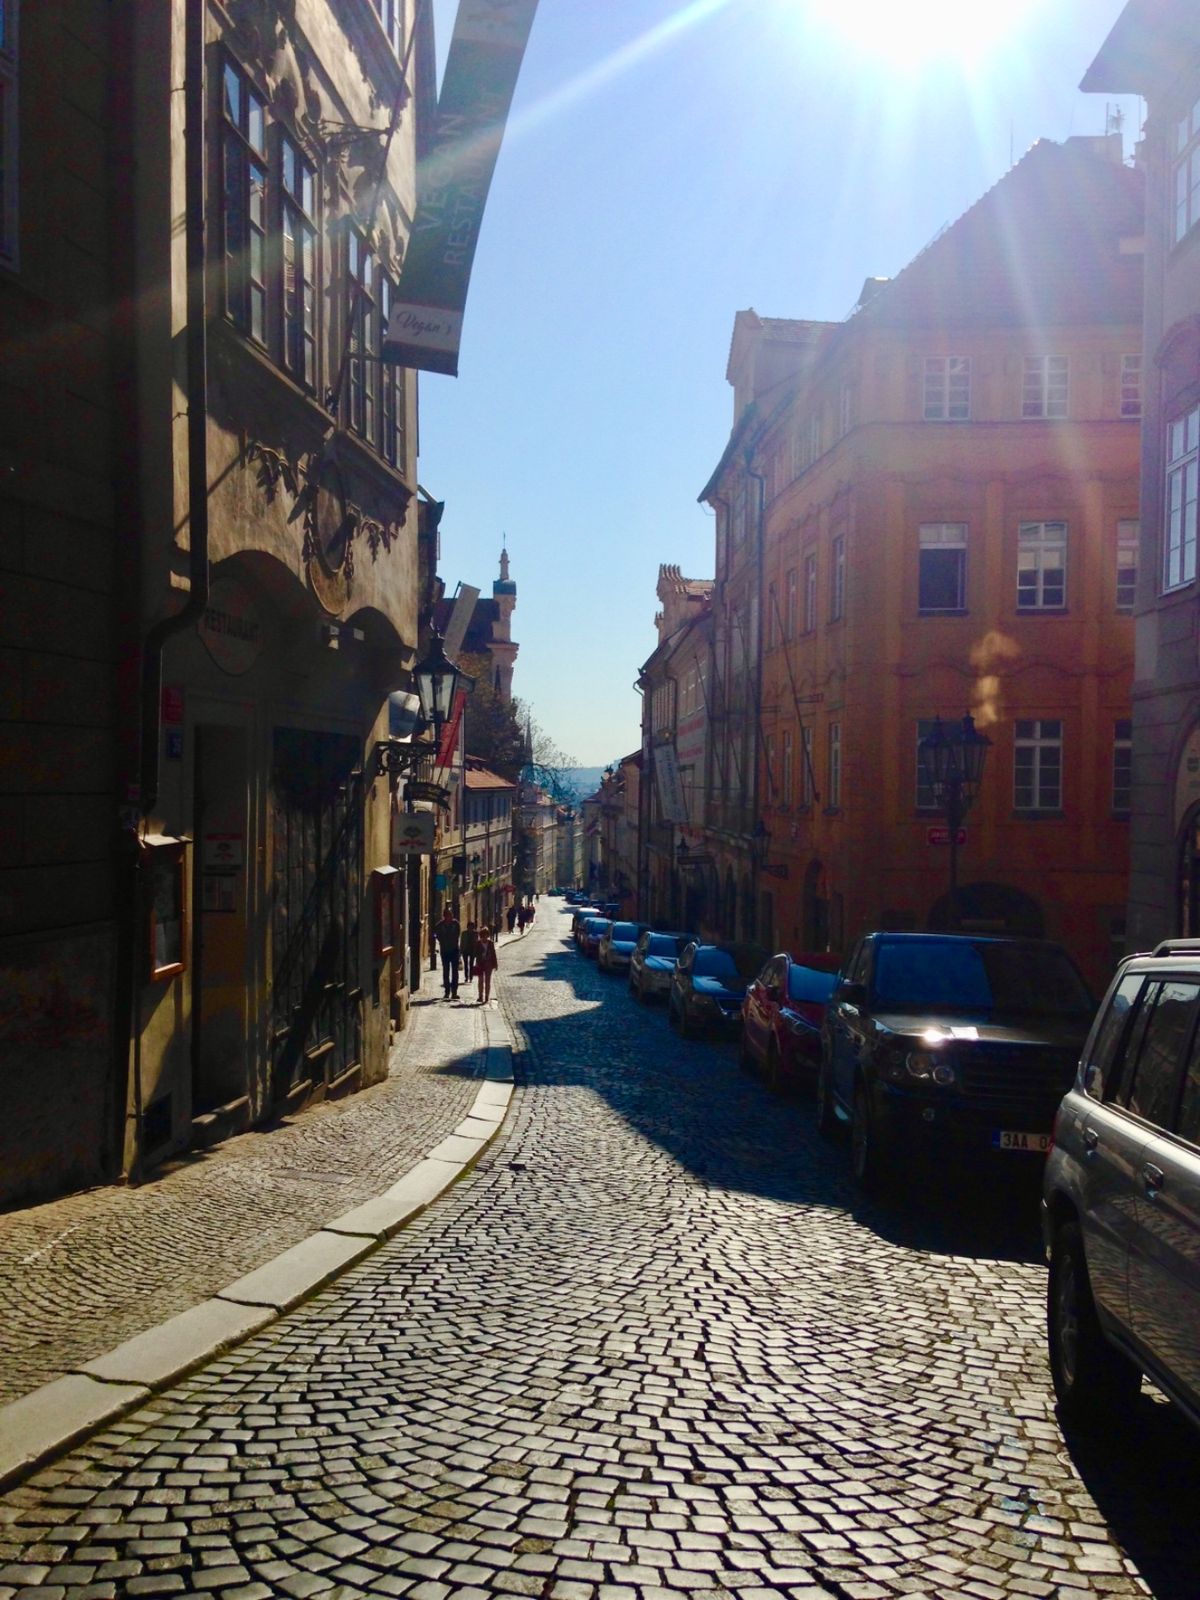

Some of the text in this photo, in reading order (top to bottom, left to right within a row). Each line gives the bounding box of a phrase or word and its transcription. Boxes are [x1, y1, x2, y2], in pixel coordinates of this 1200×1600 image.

[416, 113, 465, 231] VEGAN
[445, 84, 502, 264] RESTAURANT
[396, 311, 452, 337] Vegan's
[1003, 1133, 1028, 1148] 3AA
